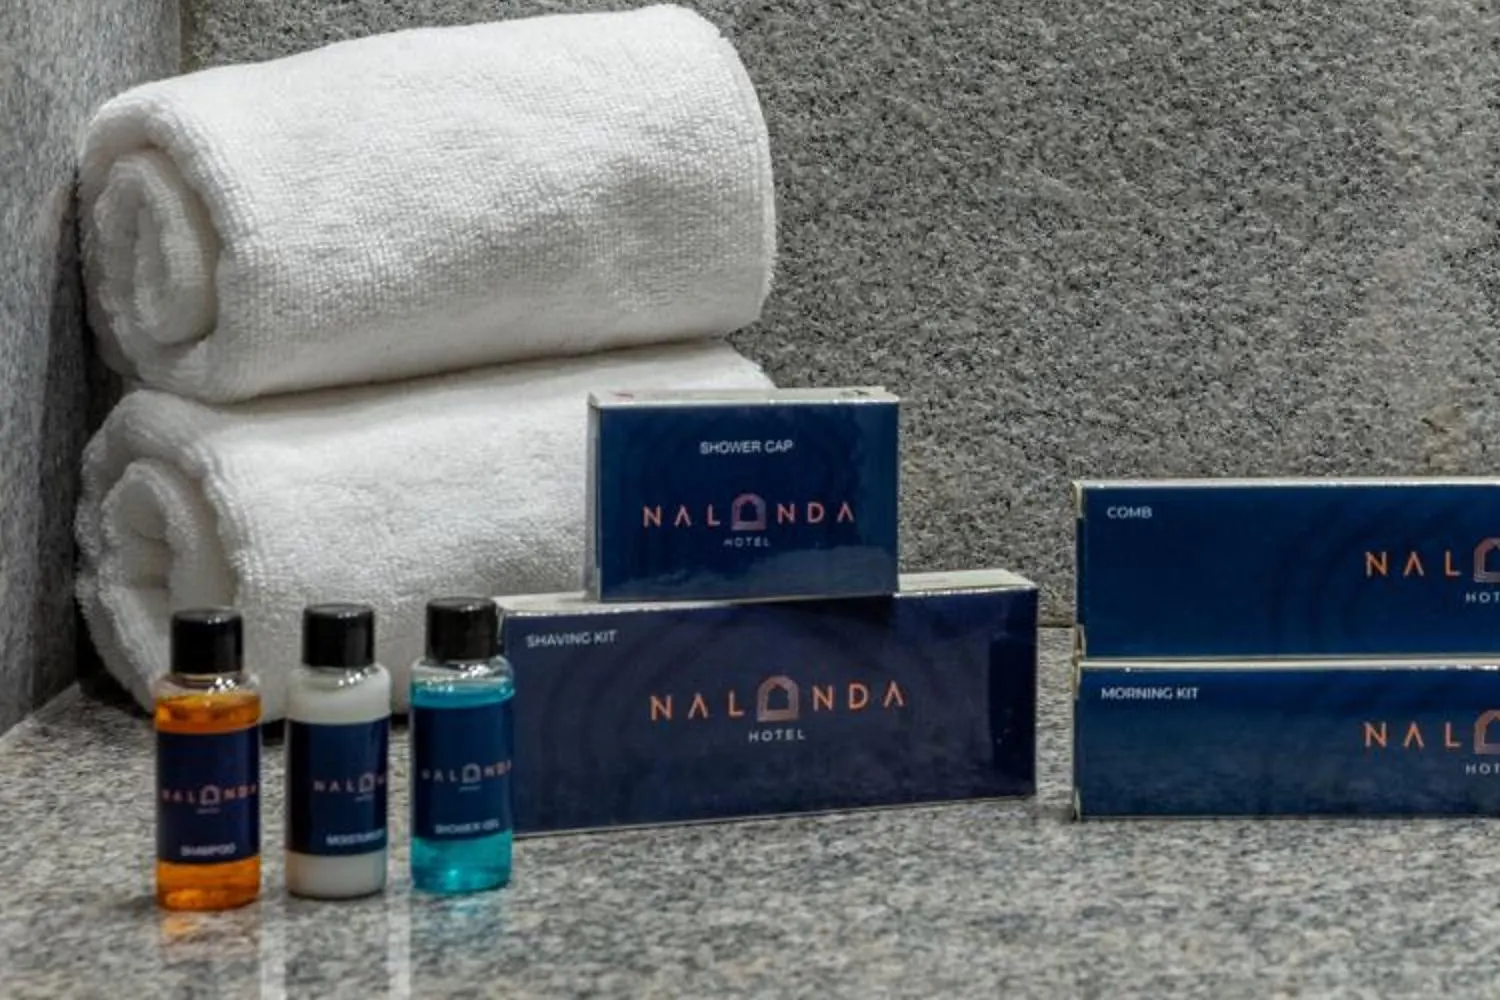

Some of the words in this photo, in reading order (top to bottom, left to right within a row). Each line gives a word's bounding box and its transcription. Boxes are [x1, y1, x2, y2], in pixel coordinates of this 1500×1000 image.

[700, 439, 761, 454] SHOWER
[764, 438, 794, 453] CAP
[1106, 505, 1153, 519] COMB
[724, 537, 770, 548] HOTEL
[527, 631, 591, 649] SHAVING
[594, 629, 619, 645] KIT
[1101, 686, 1173, 700] MORNING
[1177, 686, 1199, 700] KIT
[748, 728, 806, 743] HOTEL
